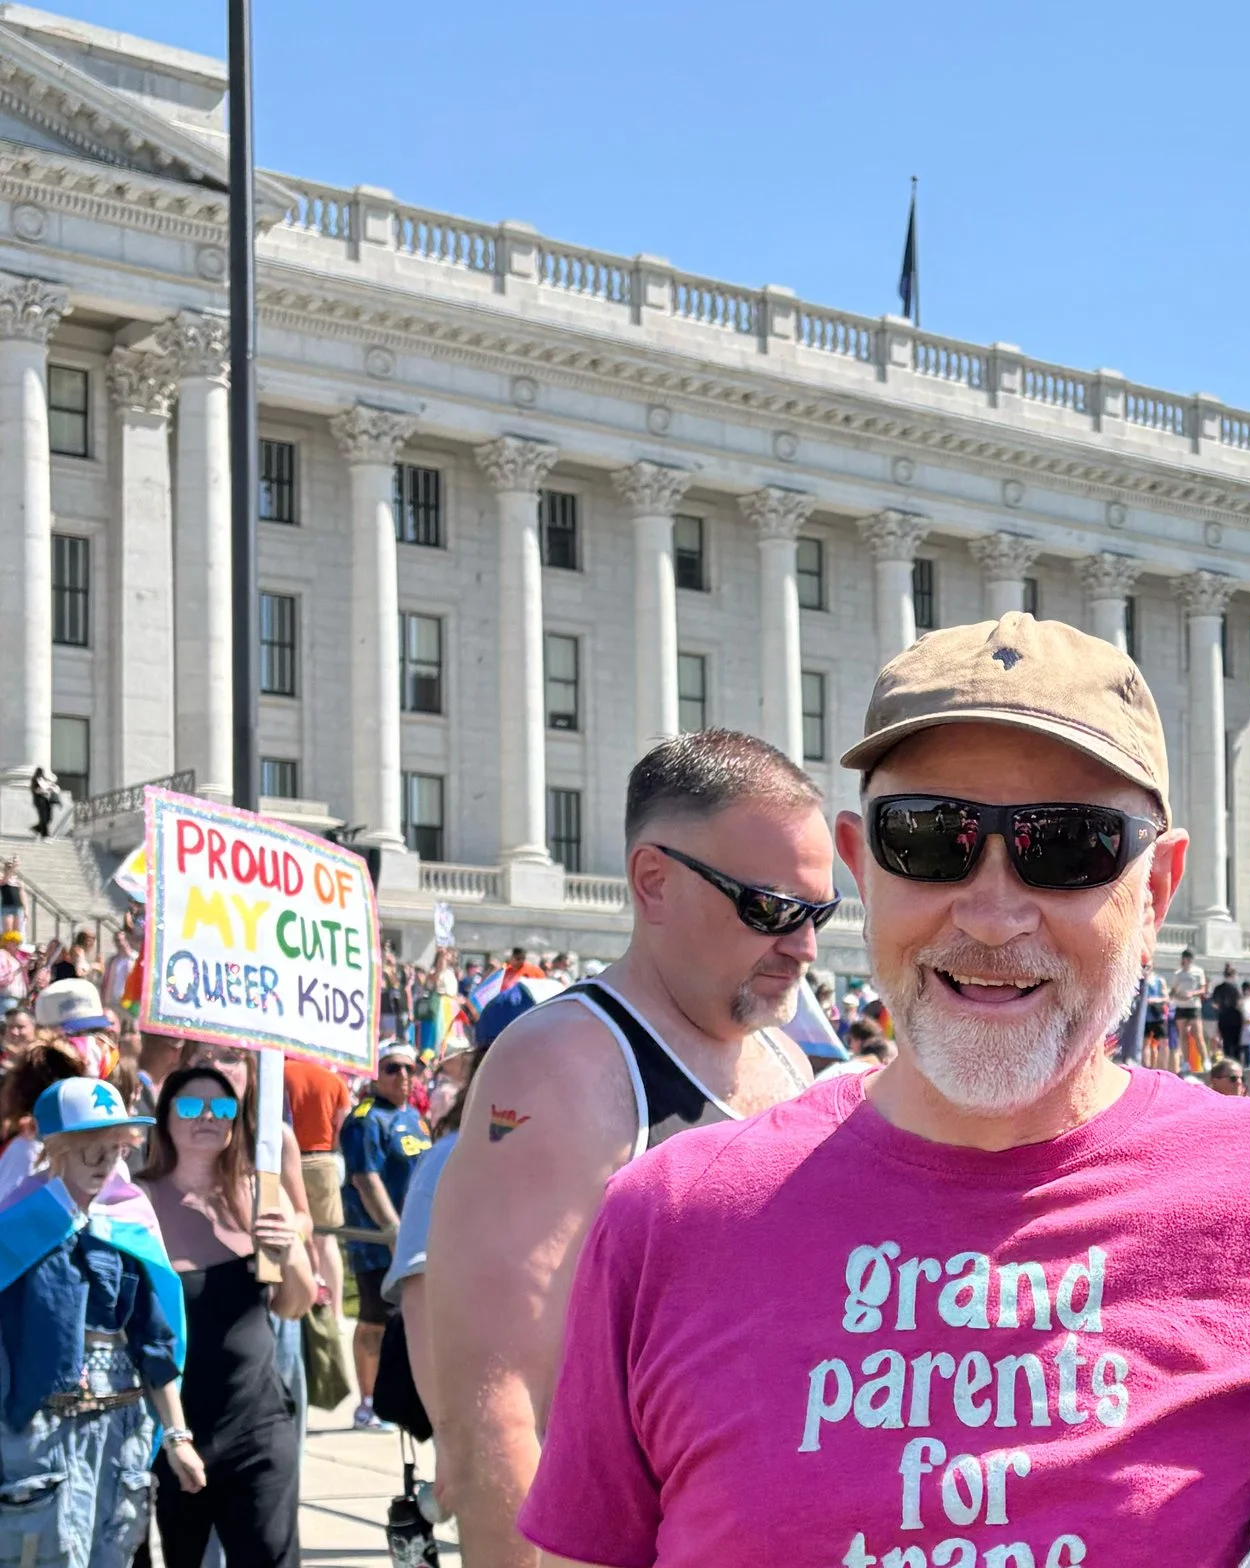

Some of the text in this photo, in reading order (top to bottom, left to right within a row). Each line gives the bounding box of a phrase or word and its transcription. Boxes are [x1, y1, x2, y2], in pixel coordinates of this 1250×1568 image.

[176, 819, 353, 910] PROUD OF
[181, 885, 363, 971] MY CUTE
[166, 949, 285, 1017] QUEER
[842, 1240, 1107, 1333] grand
[797, 1332, 1129, 1453] parents
[899, 1437, 1031, 1530] for
